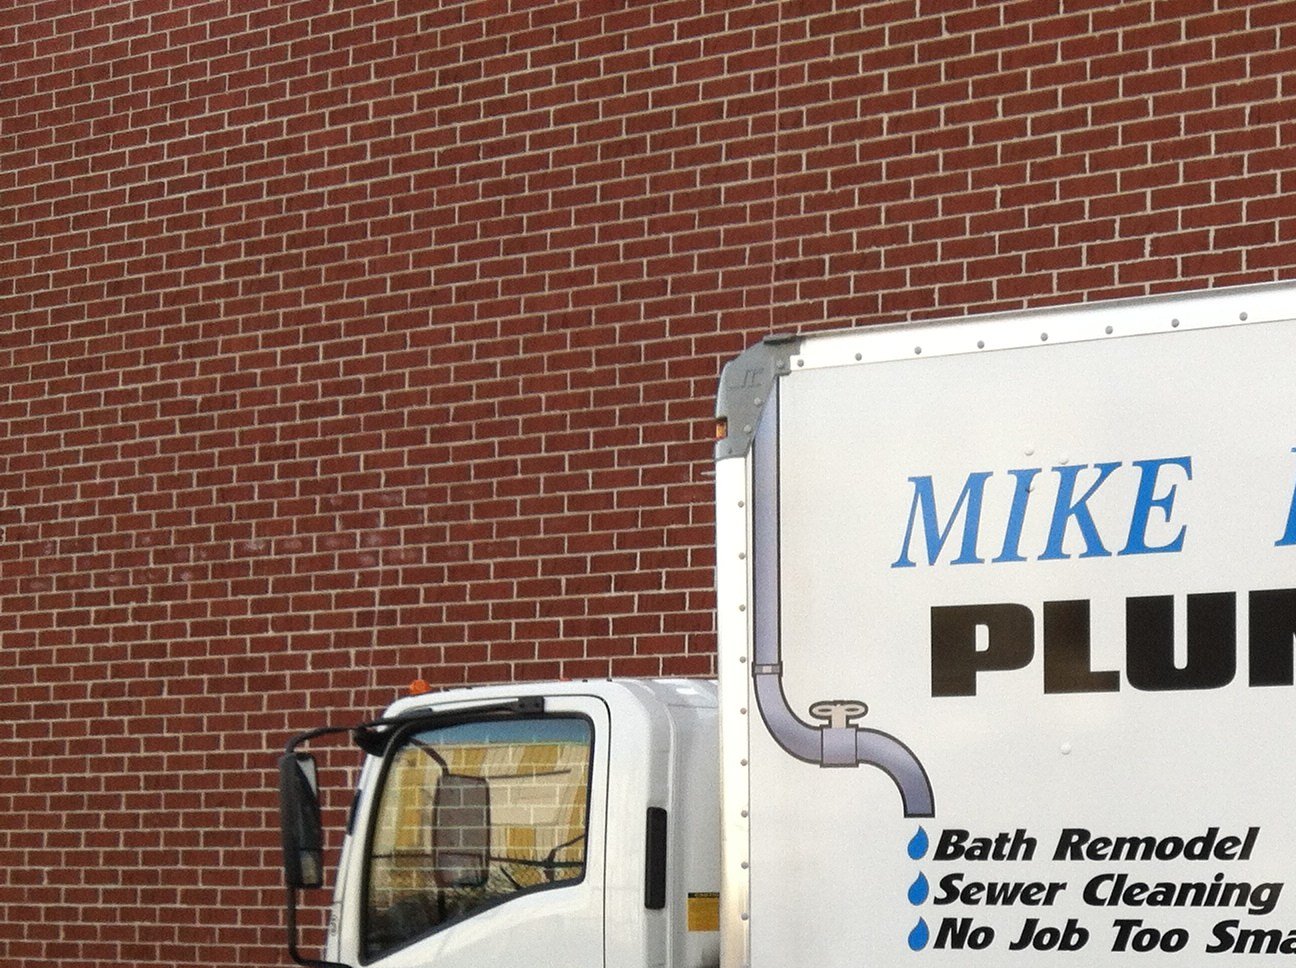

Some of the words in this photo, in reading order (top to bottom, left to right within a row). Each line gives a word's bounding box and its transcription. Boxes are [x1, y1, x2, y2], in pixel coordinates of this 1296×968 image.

[891, 455, 1193, 568] MIKE
[932, 828, 1037, 861] Bath
[1052, 827, 1261, 861] Remodel
[933, 872, 1068, 906] Sewer
[1082, 872, 1284, 916] Cleaning
[932, 917, 995, 950] No
[1008, 918, 1090, 952] Job
[1111, 918, 1190, 953] Too
